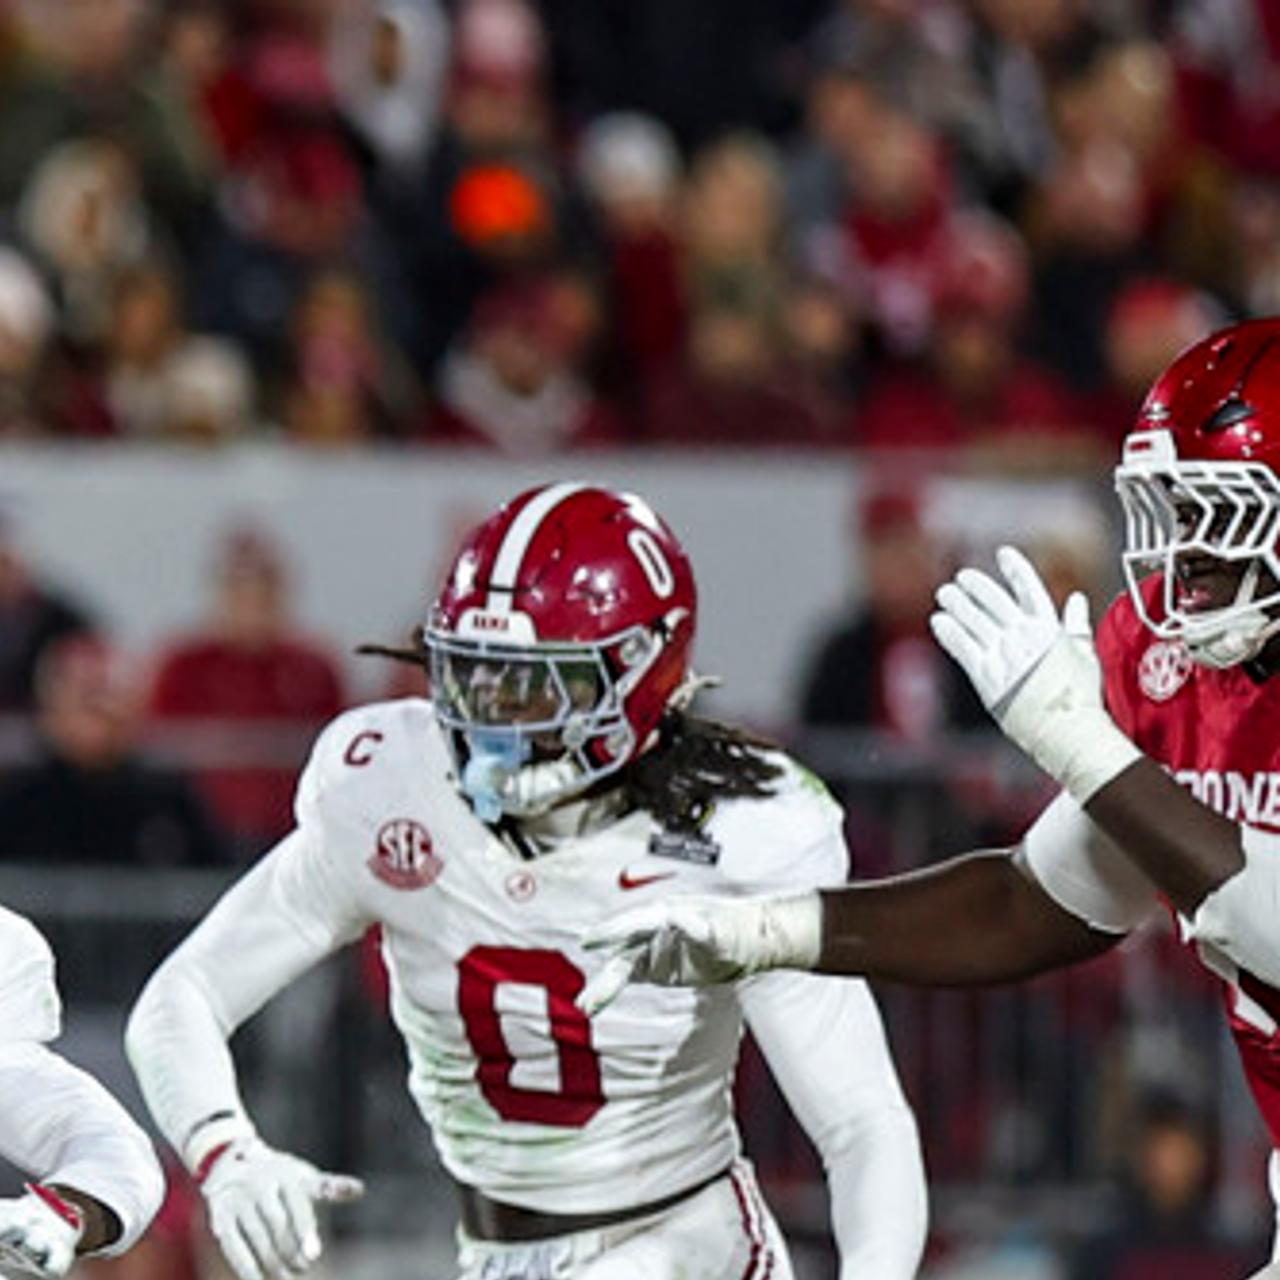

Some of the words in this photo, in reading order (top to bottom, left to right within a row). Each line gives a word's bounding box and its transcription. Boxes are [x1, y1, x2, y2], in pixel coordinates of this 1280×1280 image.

[627, 528, 674, 598] 0
[343, 730, 384, 767] C
[456, 944, 607, 1128] 0
